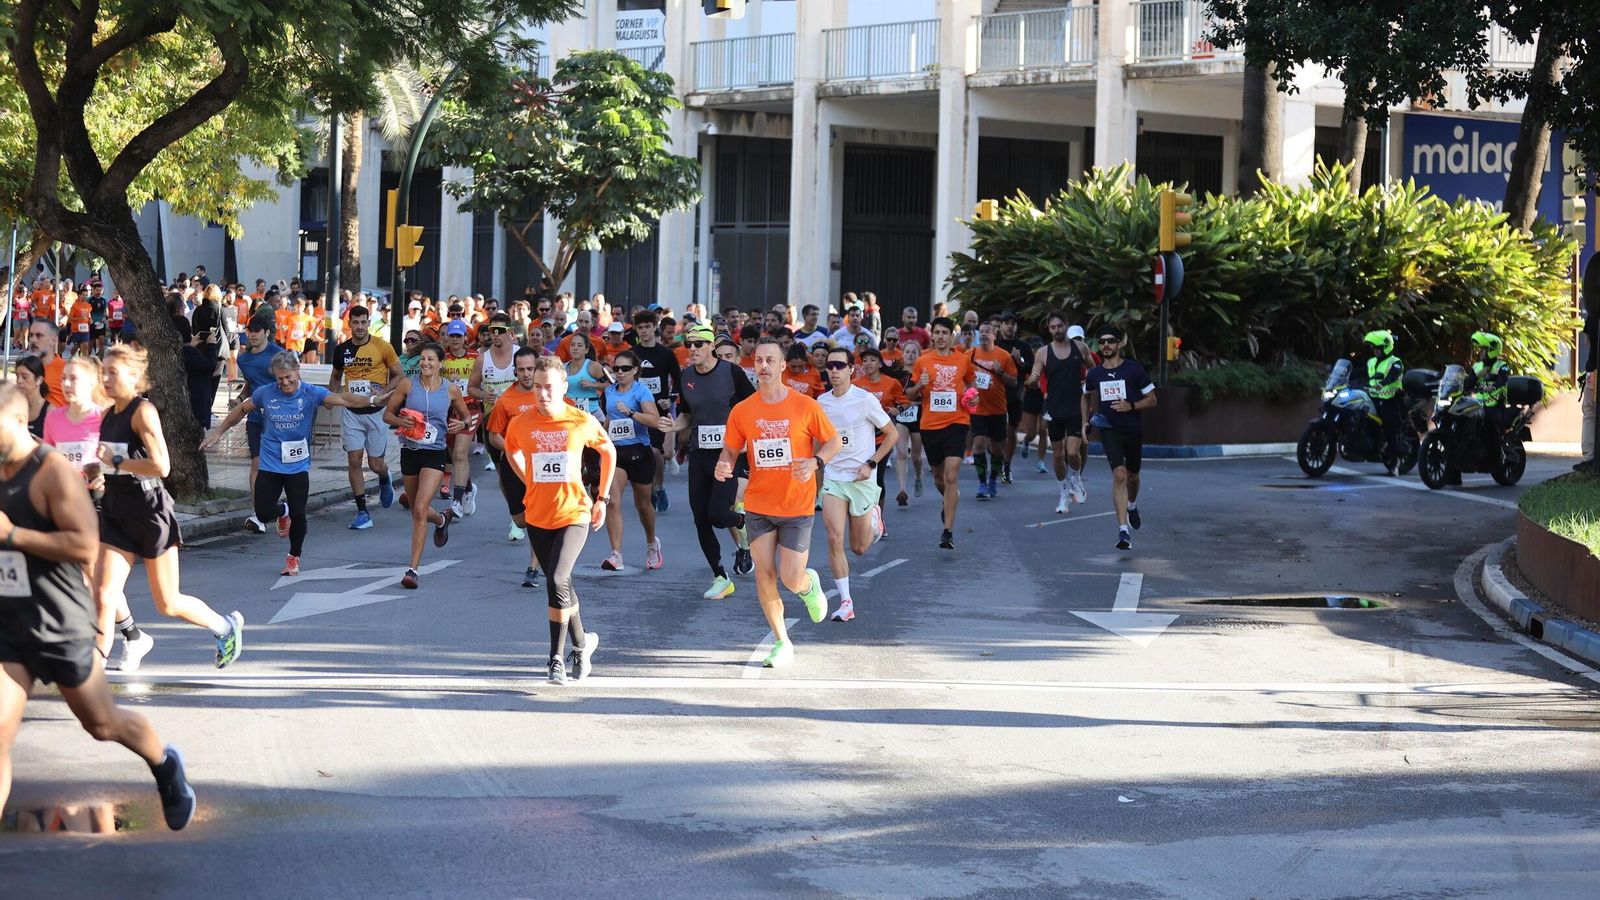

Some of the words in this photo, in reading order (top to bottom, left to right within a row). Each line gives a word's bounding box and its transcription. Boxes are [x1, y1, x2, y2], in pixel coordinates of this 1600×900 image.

[646, 17, 660, 28] VIP
[933, 398, 952, 406] 884
[611, 426, 630, 434] 408
[701, 433, 721, 442] 510
[63, 452, 83, 462] 89
[289, 447, 303, 457] 26
[758, 448, 784, 459] 666
[542, 463, 561, 473] 46
